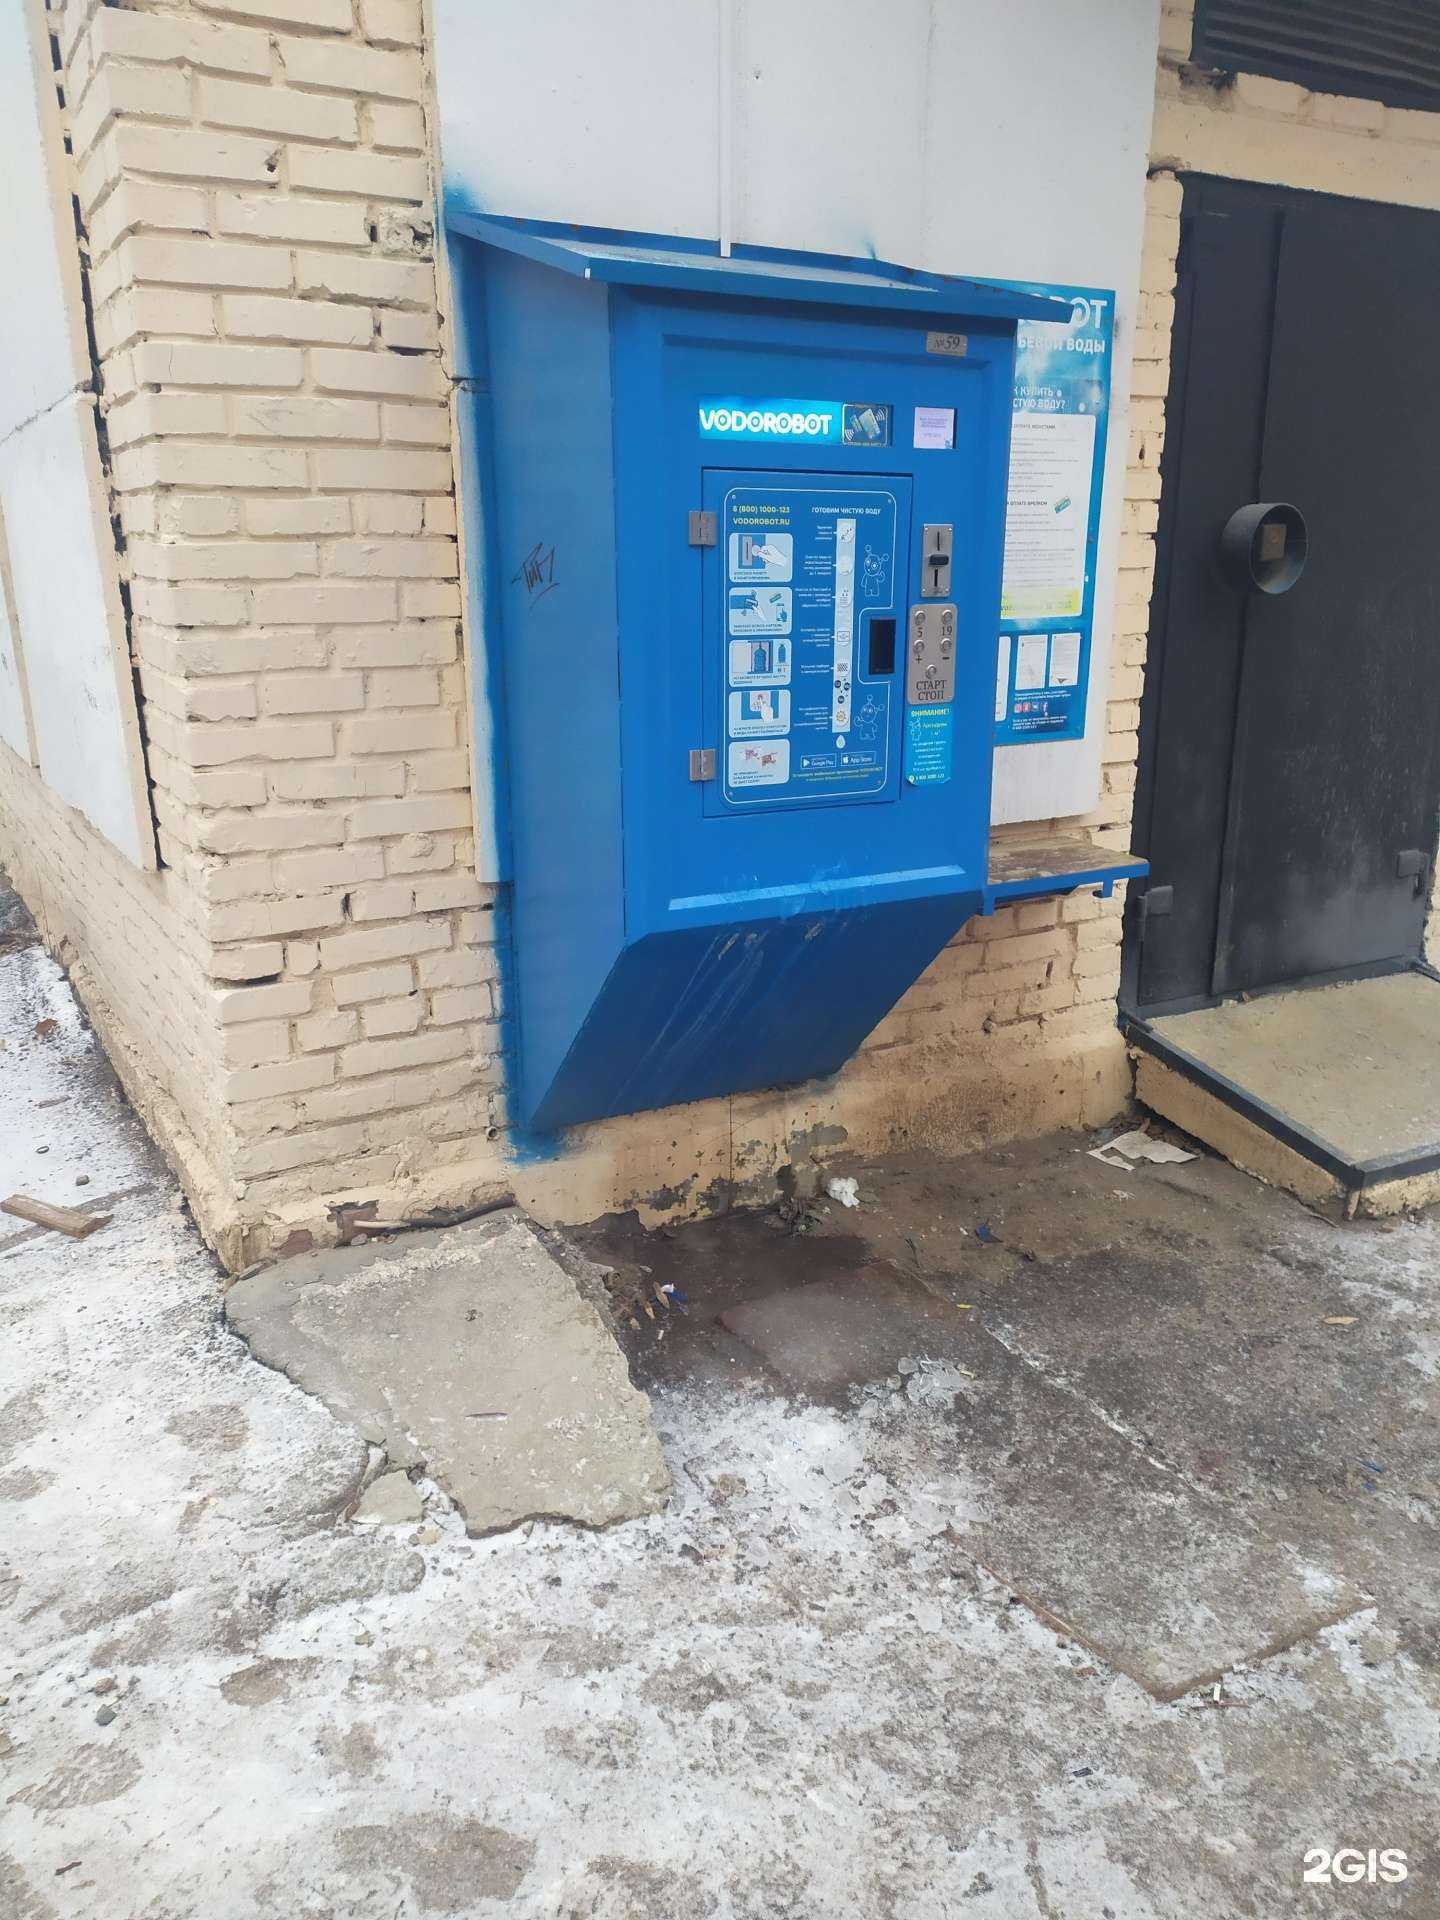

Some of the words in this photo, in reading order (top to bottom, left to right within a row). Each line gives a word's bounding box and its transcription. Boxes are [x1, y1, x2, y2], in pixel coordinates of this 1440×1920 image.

[1067, 338, 1105, 354] ВОДЫ
[699, 408, 833, 435] VODOROBOT
[739, 505, 758, 514] (800)
[760, 505, 790, 513] 1000-123
[733, 517, 790, 526] VODOROBOT.RU
[917, 628, 923, 638] 5
[942, 626, 952, 636] 19
[916, 679, 947, 691] СТАРТ
[918, 691, 944, 701] СТОП
